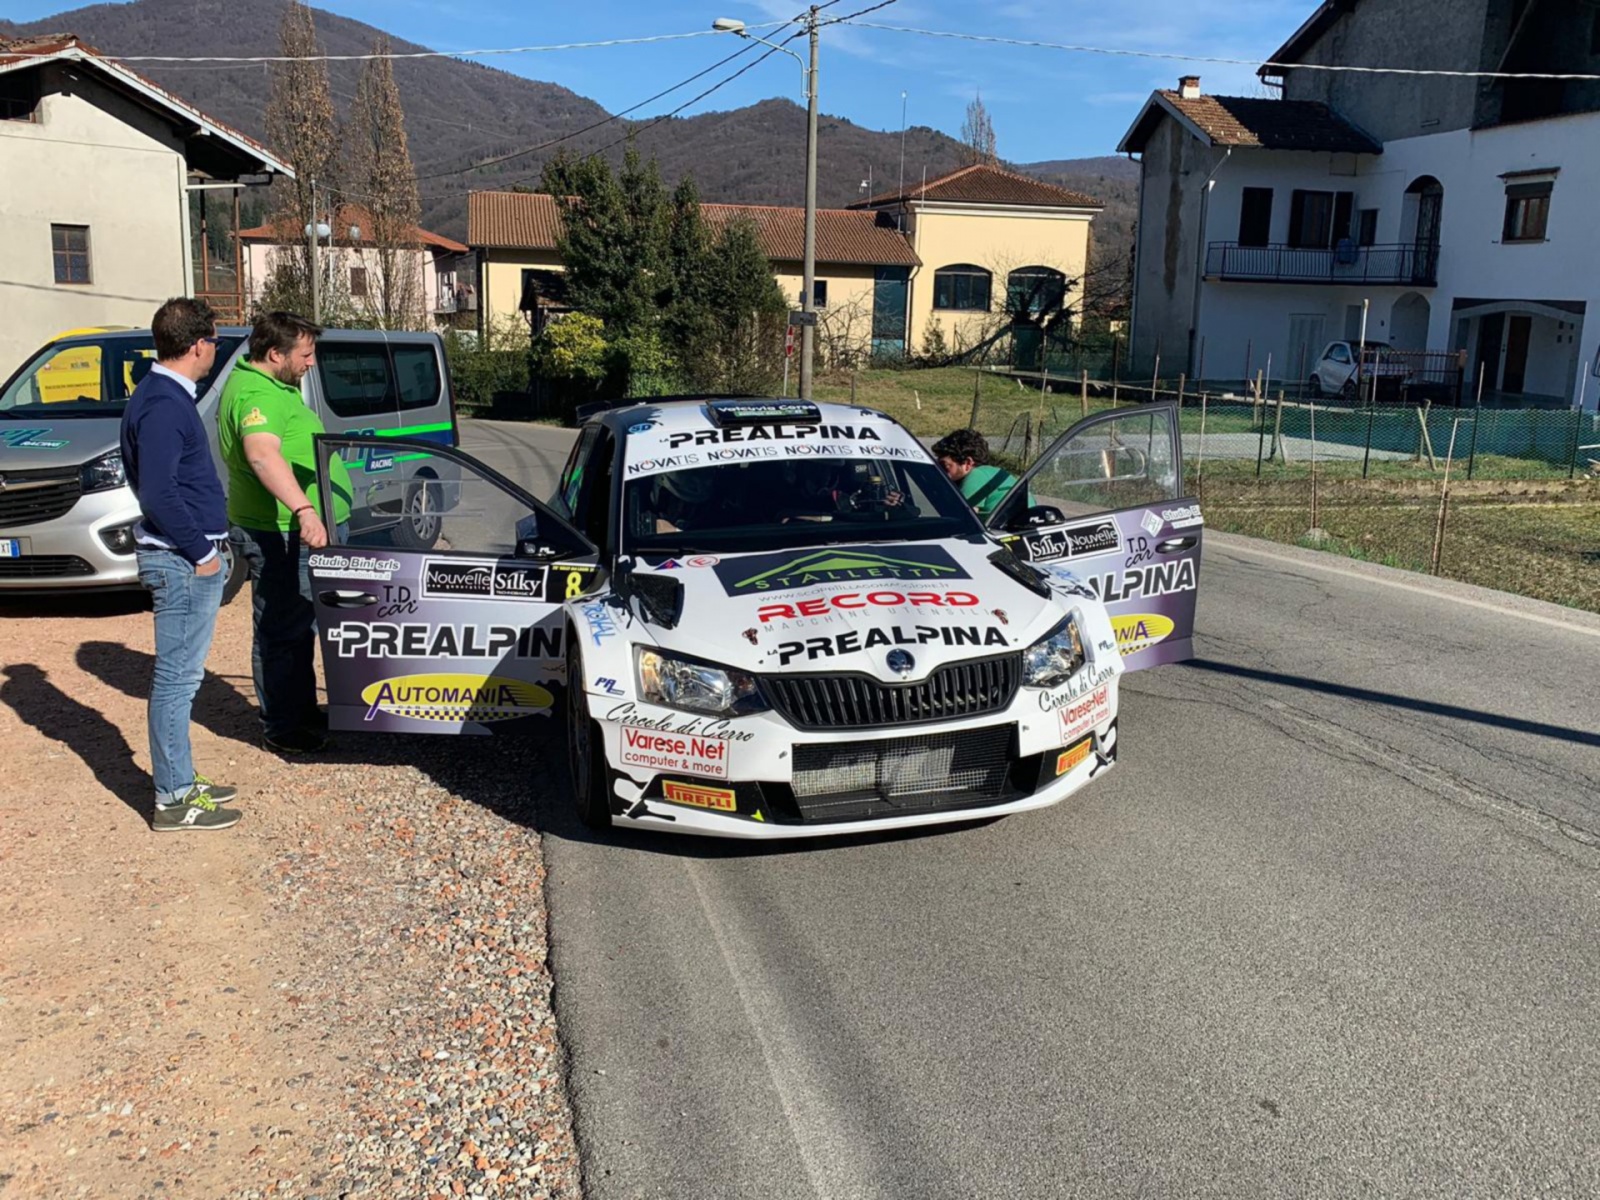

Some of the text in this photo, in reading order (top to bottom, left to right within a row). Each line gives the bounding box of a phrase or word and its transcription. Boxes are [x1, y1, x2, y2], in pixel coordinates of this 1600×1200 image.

[670, 424, 881, 449] PREALPINA
[371, 458, 392, 470] RACING
[628, 444, 925, 474] NOVATIS NOVATIS NOVATIS NOVATIS
[1031, 529, 1119, 557] Silky Nouvelle
[310, 555, 400, 570] Studio Bini srls
[427, 569, 542, 595] Nouvelle Silky
[565, 572, 582, 599] 8
[755, 568, 941, 589] STALLETTI
[376, 601, 418, 618] car
[757, 591, 980, 623] RECORD
[764, 606, 990, 633] MACCHINE UTENSILI
[342, 624, 565, 657] PREALPIN
[778, 625, 1010, 666] PREALPINA
[364, 683, 520, 720] AUTOMANIA
[1038, 665, 1115, 712] Circolo di Cerro
[606, 702, 755, 742] Circolo di Cerro
[1063, 718, 1090, 740] computer
[625, 729, 725, 760] Varese.Net
[1058, 740, 1091, 773] PIRELLI
[625, 752, 723, 775] computer & more
[664, 783, 733, 809] PIRELLI
